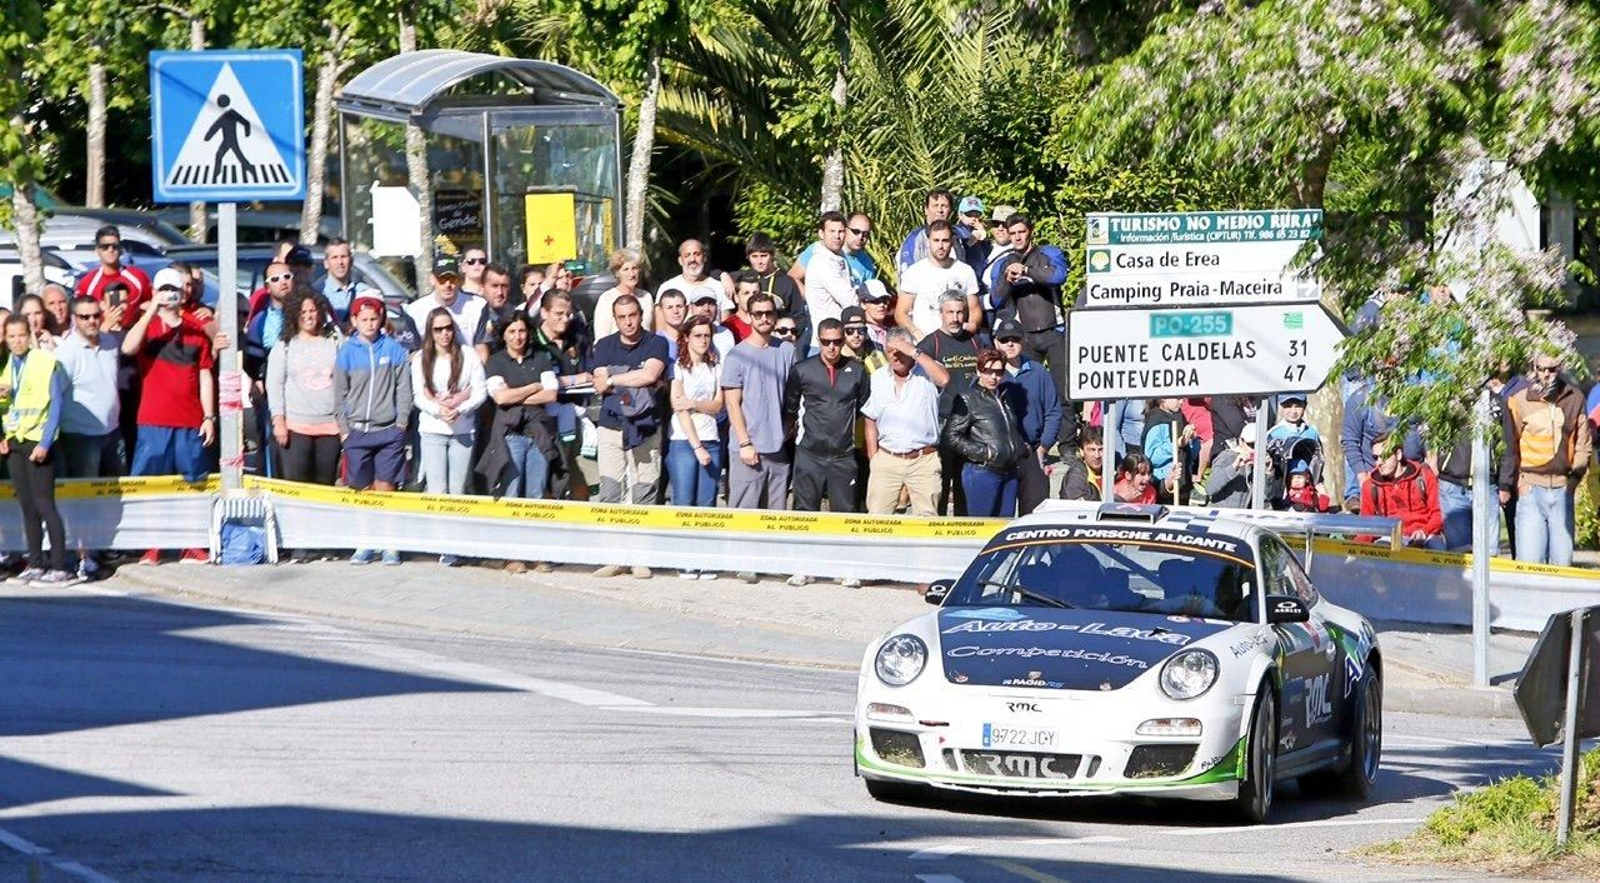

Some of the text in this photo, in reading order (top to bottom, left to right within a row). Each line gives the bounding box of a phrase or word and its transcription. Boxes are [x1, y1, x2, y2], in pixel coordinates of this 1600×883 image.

[1110, 217, 1181, 231] TURISMO
[1186, 215, 1211, 230] NO
[1216, 214, 1265, 230] MEDIO
[1288, 229, 1298, 239] 23
[1116, 251, 1220, 268] Casa de Erea
[1090, 282, 1161, 302] Camping
[1155, 315, 1227, 334] PO-255
[1078, 339, 1307, 364] PUENTE CALDELAS 31
[1078, 364, 1306, 390] PONTEVEDRA 47
[1005, 528, 1238, 553] CENTRO PORSCHE ALICANTE
[946, 646, 1148, 669] Competición
[992, 728, 1027, 745] 9722
